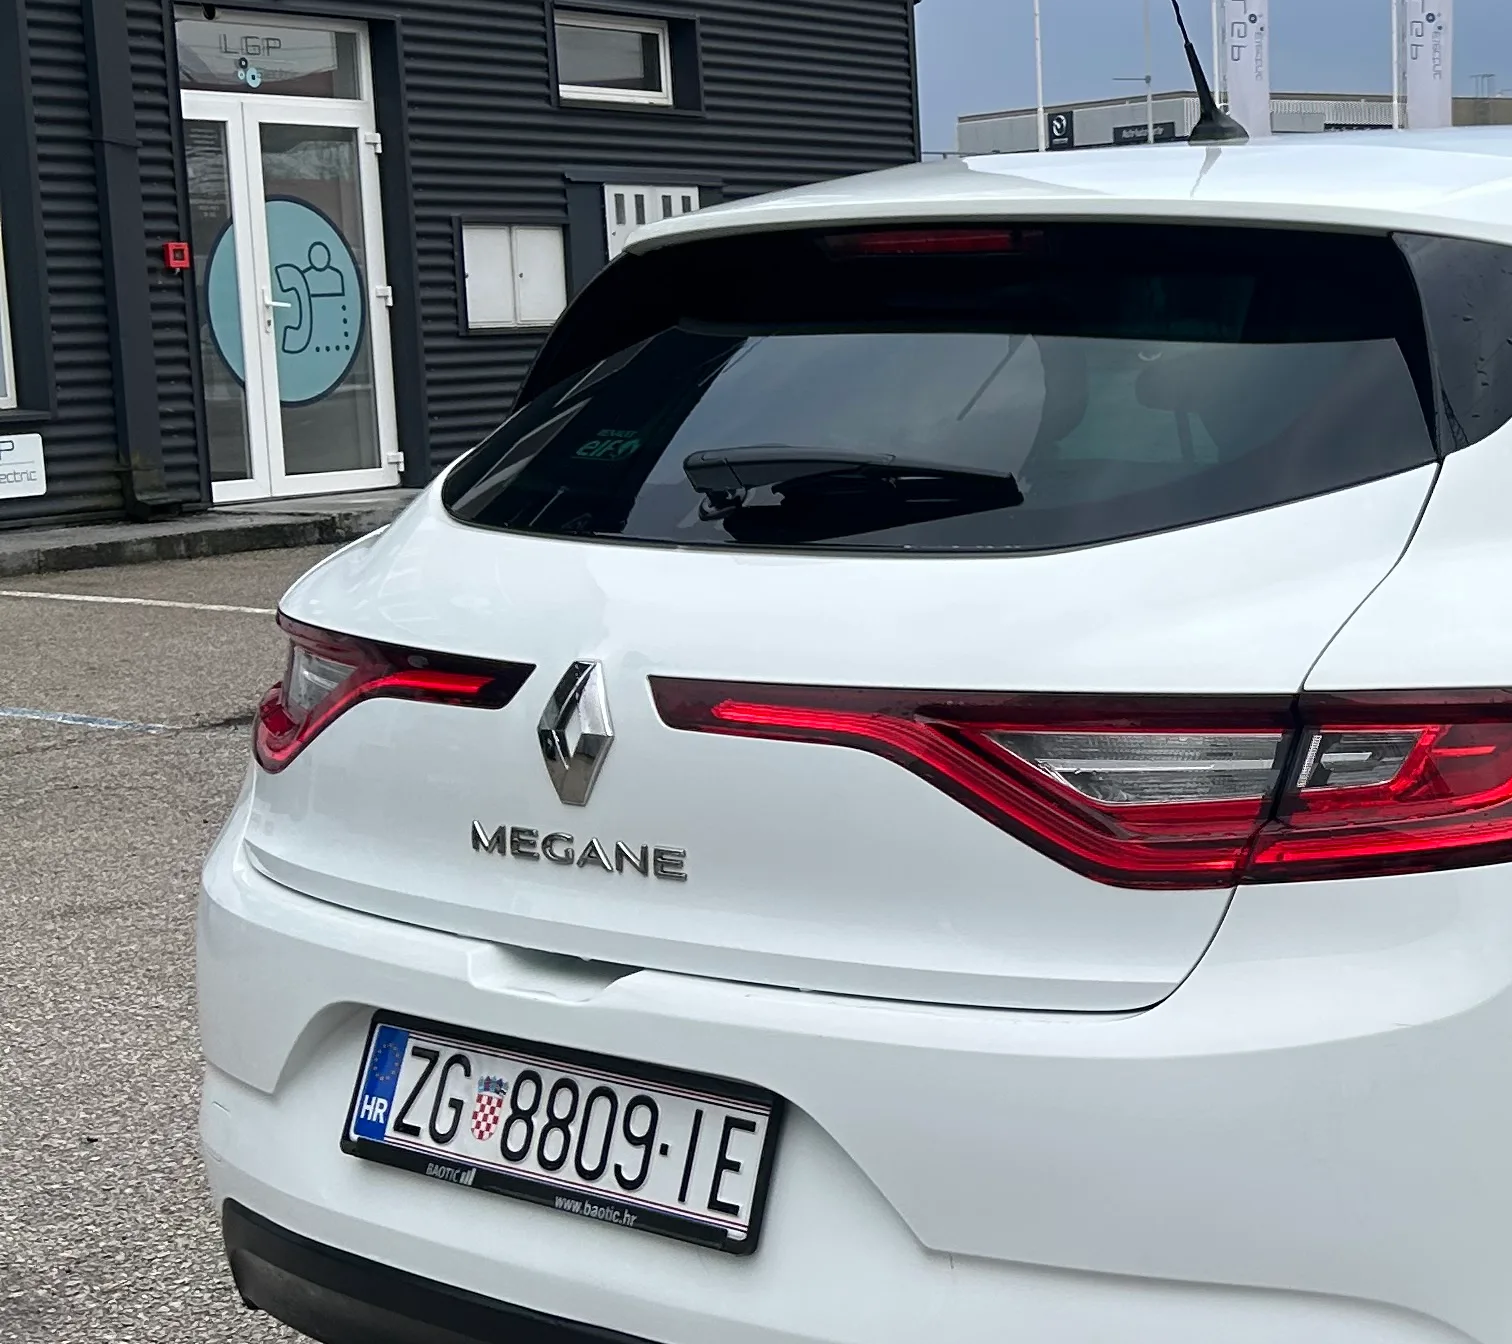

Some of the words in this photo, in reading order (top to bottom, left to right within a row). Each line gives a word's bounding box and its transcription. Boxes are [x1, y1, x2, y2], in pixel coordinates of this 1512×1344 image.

[219, 33, 282, 57] LGP
[471, 819, 689, 883] MEGANE
[359, 1093, 389, 1126] HR
[392, 1045, 472, 1146] ZG
[554, 1194, 638, 1228] www.baotic.hr
